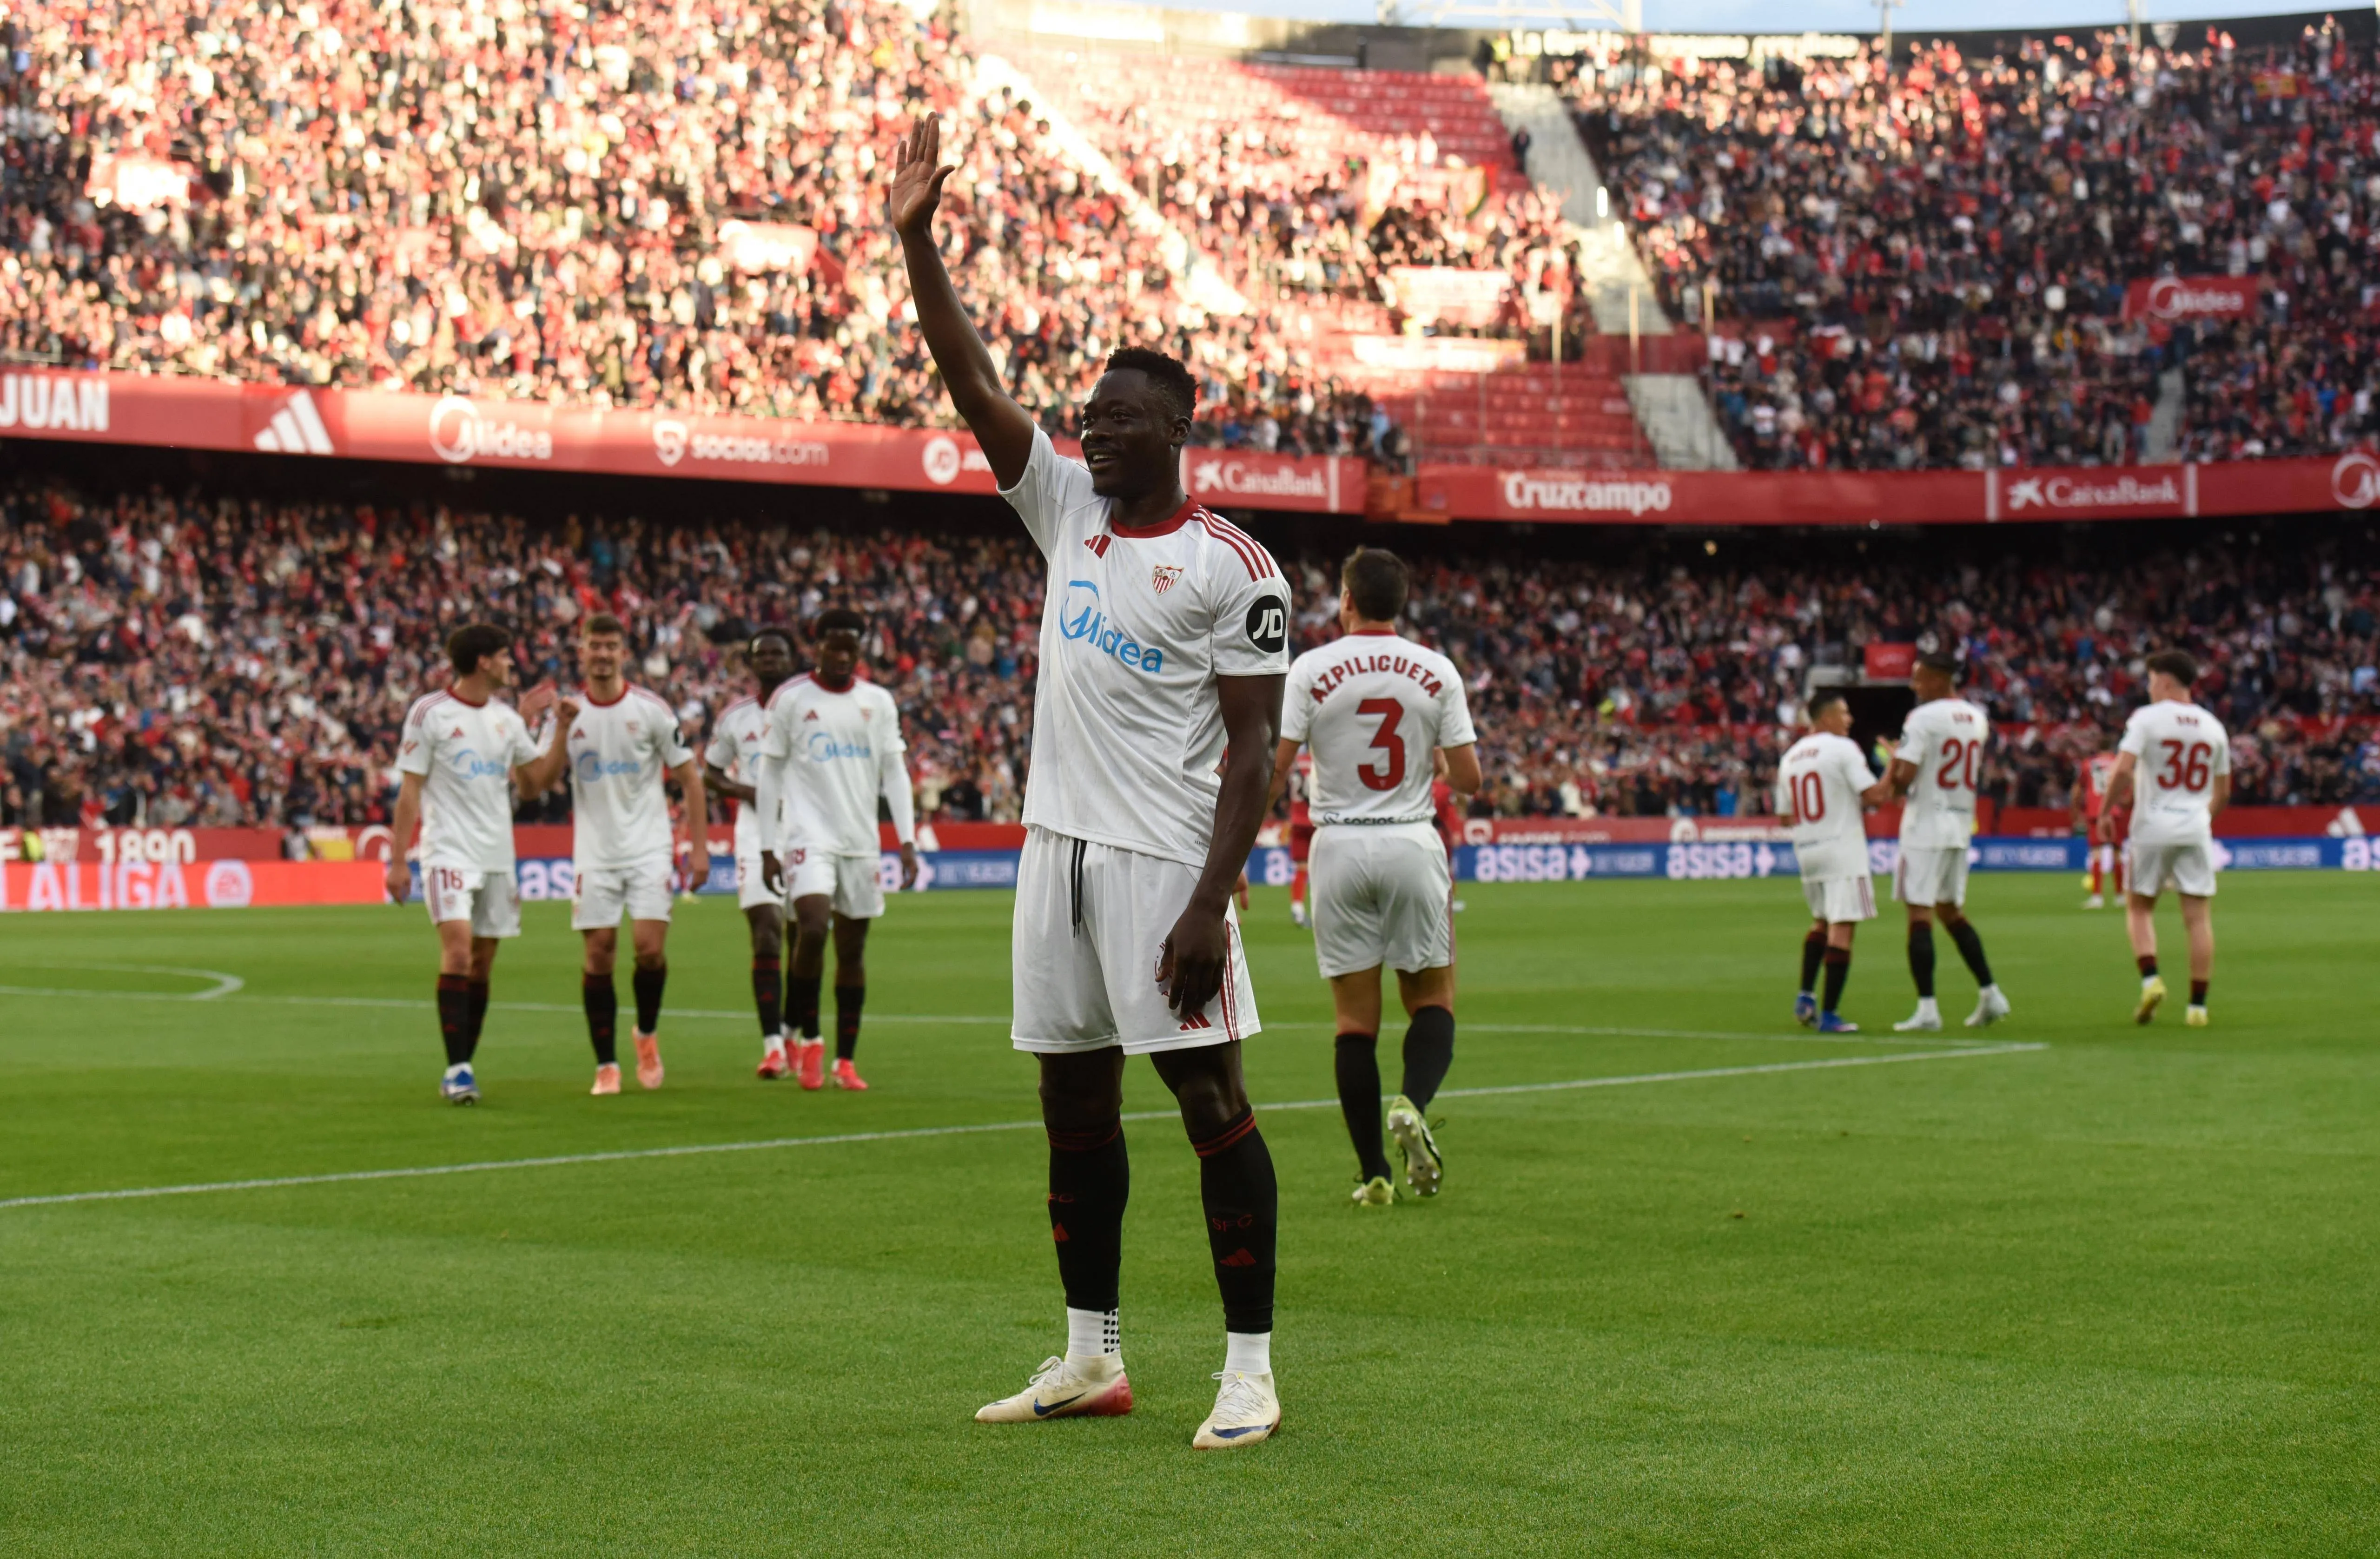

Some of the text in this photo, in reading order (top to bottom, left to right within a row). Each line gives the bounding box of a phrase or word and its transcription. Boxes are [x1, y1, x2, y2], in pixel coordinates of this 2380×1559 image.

[0, 375, 110, 432] JUAN
[429, 395, 553, 462] Midea
[691, 432, 829, 465] socios.com
[1222, 462, 1328, 497] CaixaBank
[1505, 472, 1672, 516] Cruzcampo
[2046, 475, 2180, 508] CaixaBank
[1060, 580, 1163, 673] Midea
[1253, 608, 1283, 640] JD
[1309, 655, 1443, 704] AZPILICUETA
[1355, 698, 1405, 792] 3
[1937, 738, 1980, 791] 20
[2157, 739, 2212, 793] 36
[1789, 771, 1825, 824] 10
[439, 867, 463, 891] 16
[1475, 845, 1567, 882] asisa
[1666, 843, 1752, 879] asisa
